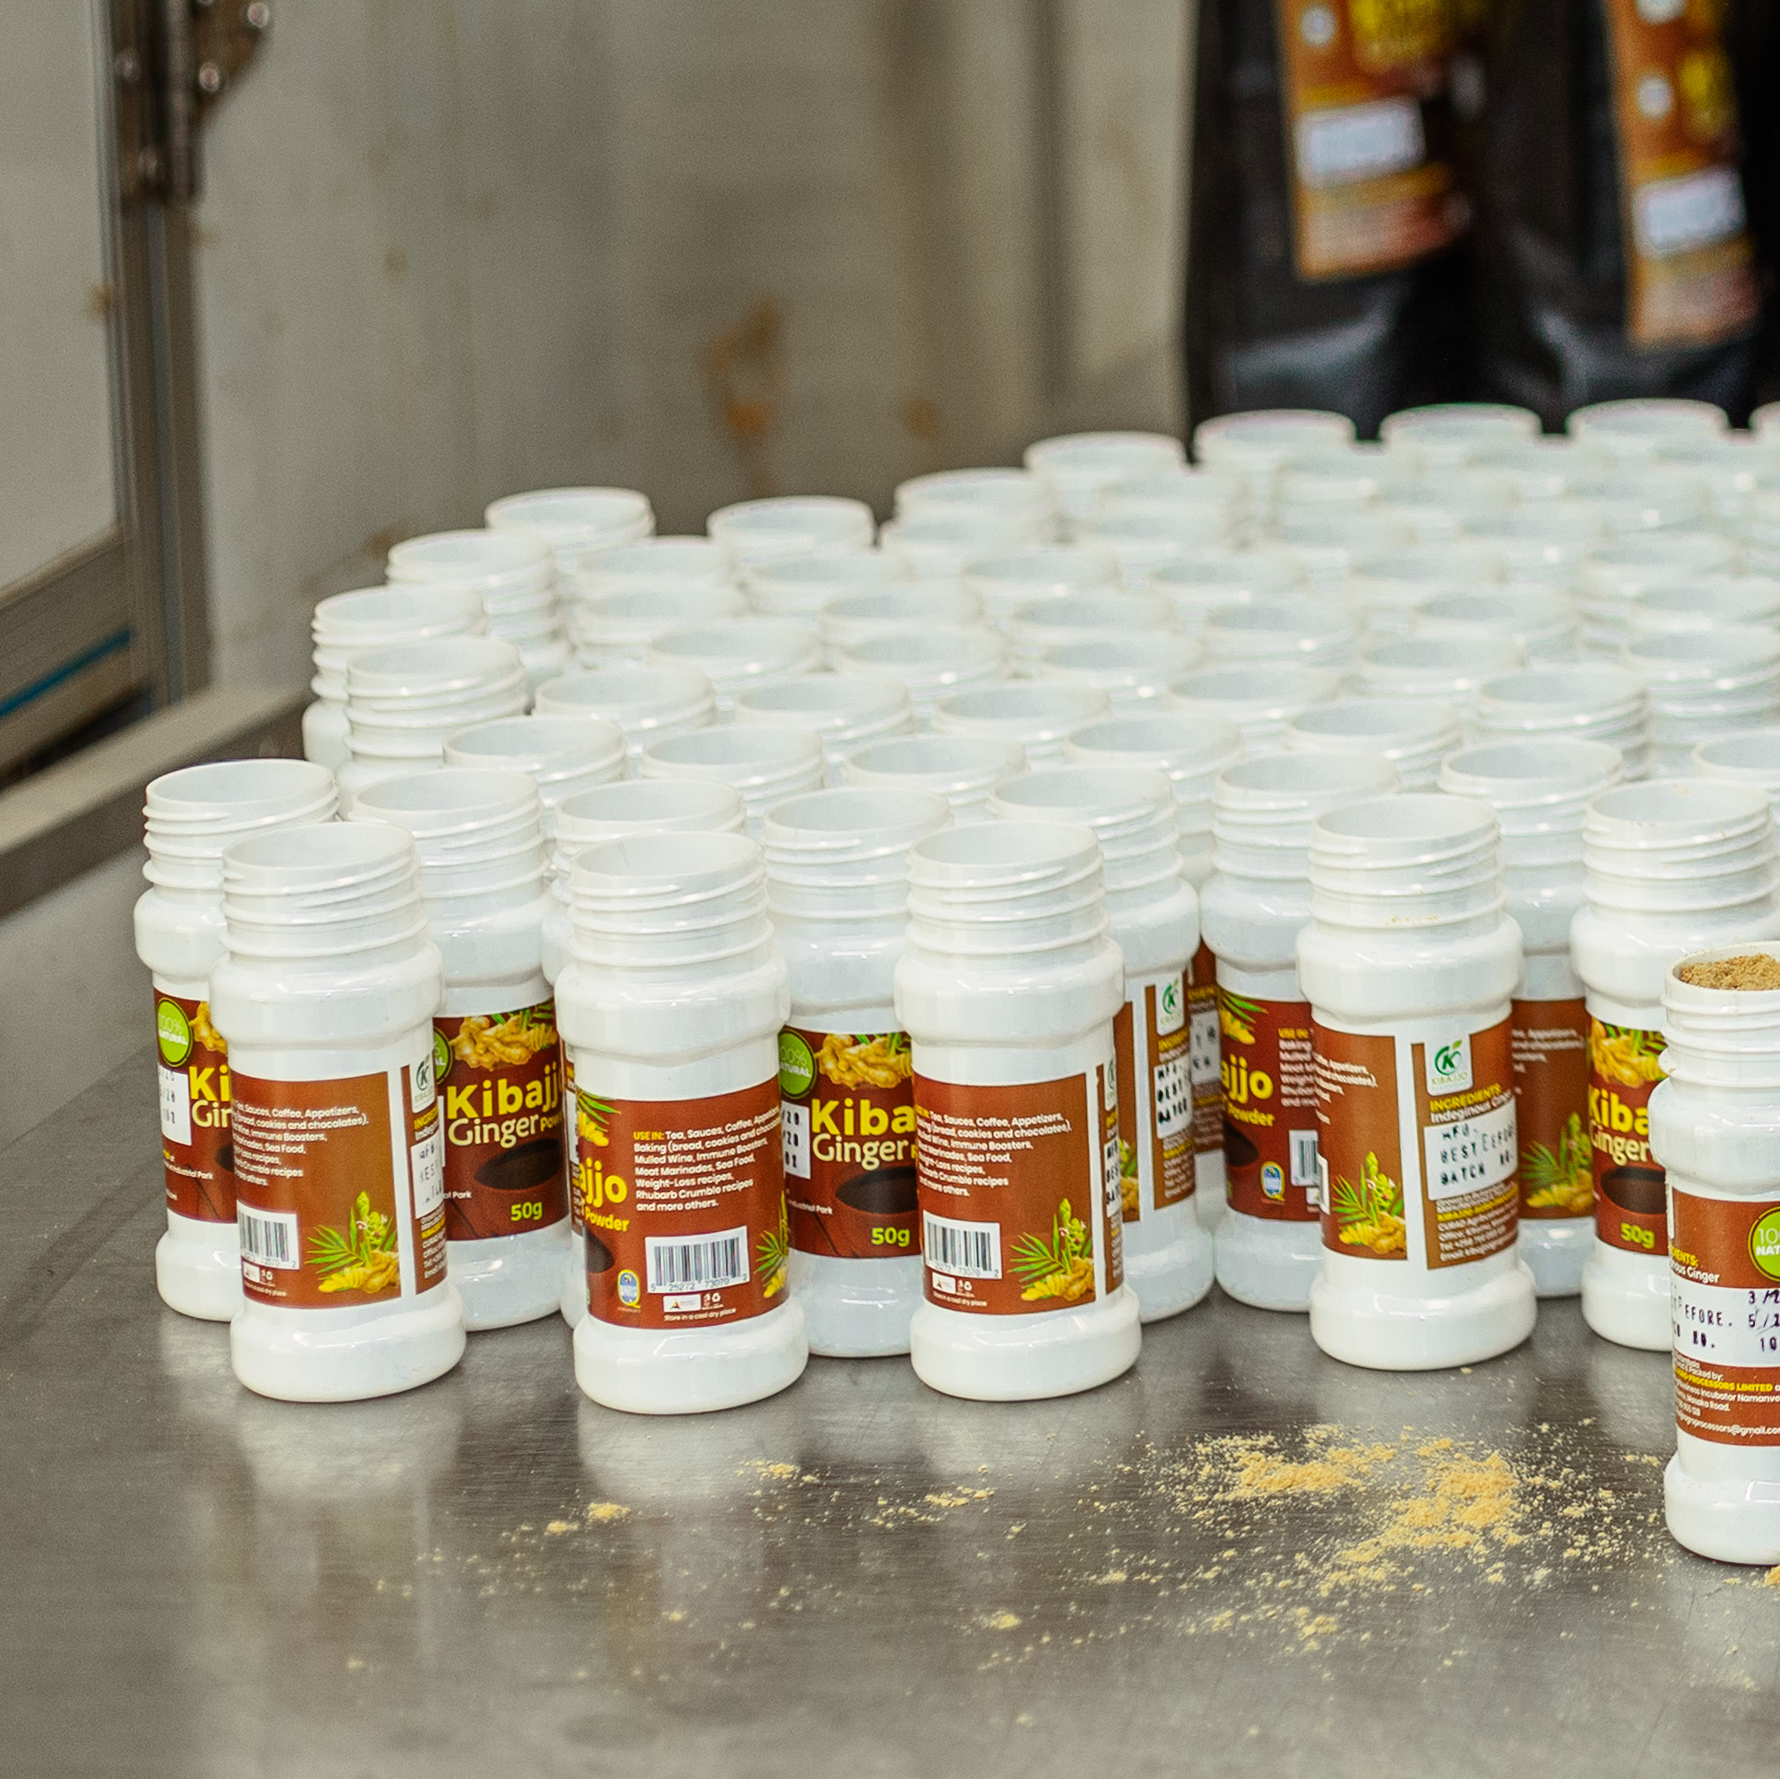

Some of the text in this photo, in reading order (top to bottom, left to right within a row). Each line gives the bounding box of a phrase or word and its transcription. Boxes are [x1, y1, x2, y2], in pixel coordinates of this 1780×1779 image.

[1588, 1082, 1649, 1136] Kiba
[811, 1097, 916, 1137] Kiba
[288, 1121, 307, 1130] and
[448, 1113, 540, 1148] Ginger
[633, 1131, 650, 1140] USE
[957, 1128, 992, 1139] cookies
[993, 1128, 1014, 1139] and
[264, 1142, 280, 1152] Sea
[634, 1143, 666, 1155] Baking
[704, 1134, 740, 1148] cookies
[740, 1129, 756, 1141] and
[951, 1139, 988, 1150] Immune
[634, 1154, 666, 1164] Mulled
[696, 1148, 736, 1161] Immune
[812, 1133, 910, 1170] Ginger
[966, 1153, 984, 1162] Sea
[270, 1167, 304, 1180] recipes
[635, 1166, 660, 1176] Meat
[716, 1160, 734, 1170] Sea
[578, 1156, 628, 1208] ajjo
[635, 1177, 696, 1191] Weight-Loss
[636, 1178, 754, 1200] Rhubarb Crumble recipes
[973, 1176, 1010, 1188] recipes
[452, 1191, 472, 1200] Park
[510, 1202, 543, 1222] 50g
[636, 1198, 719, 1212] and more others.
[816, 1205, 833, 1215] Park
[585, 1206, 630, 1232] Powder
[872, 1227, 910, 1248] 50g
[1620, 1222, 1656, 1250] 50g
[1687, 1264, 1720, 1284] Ginger
[650, 1283, 656, 1292] 5
[668, 1282, 696, 1292] 25272
[1736, 1383, 1773, 1392] LIMITED
